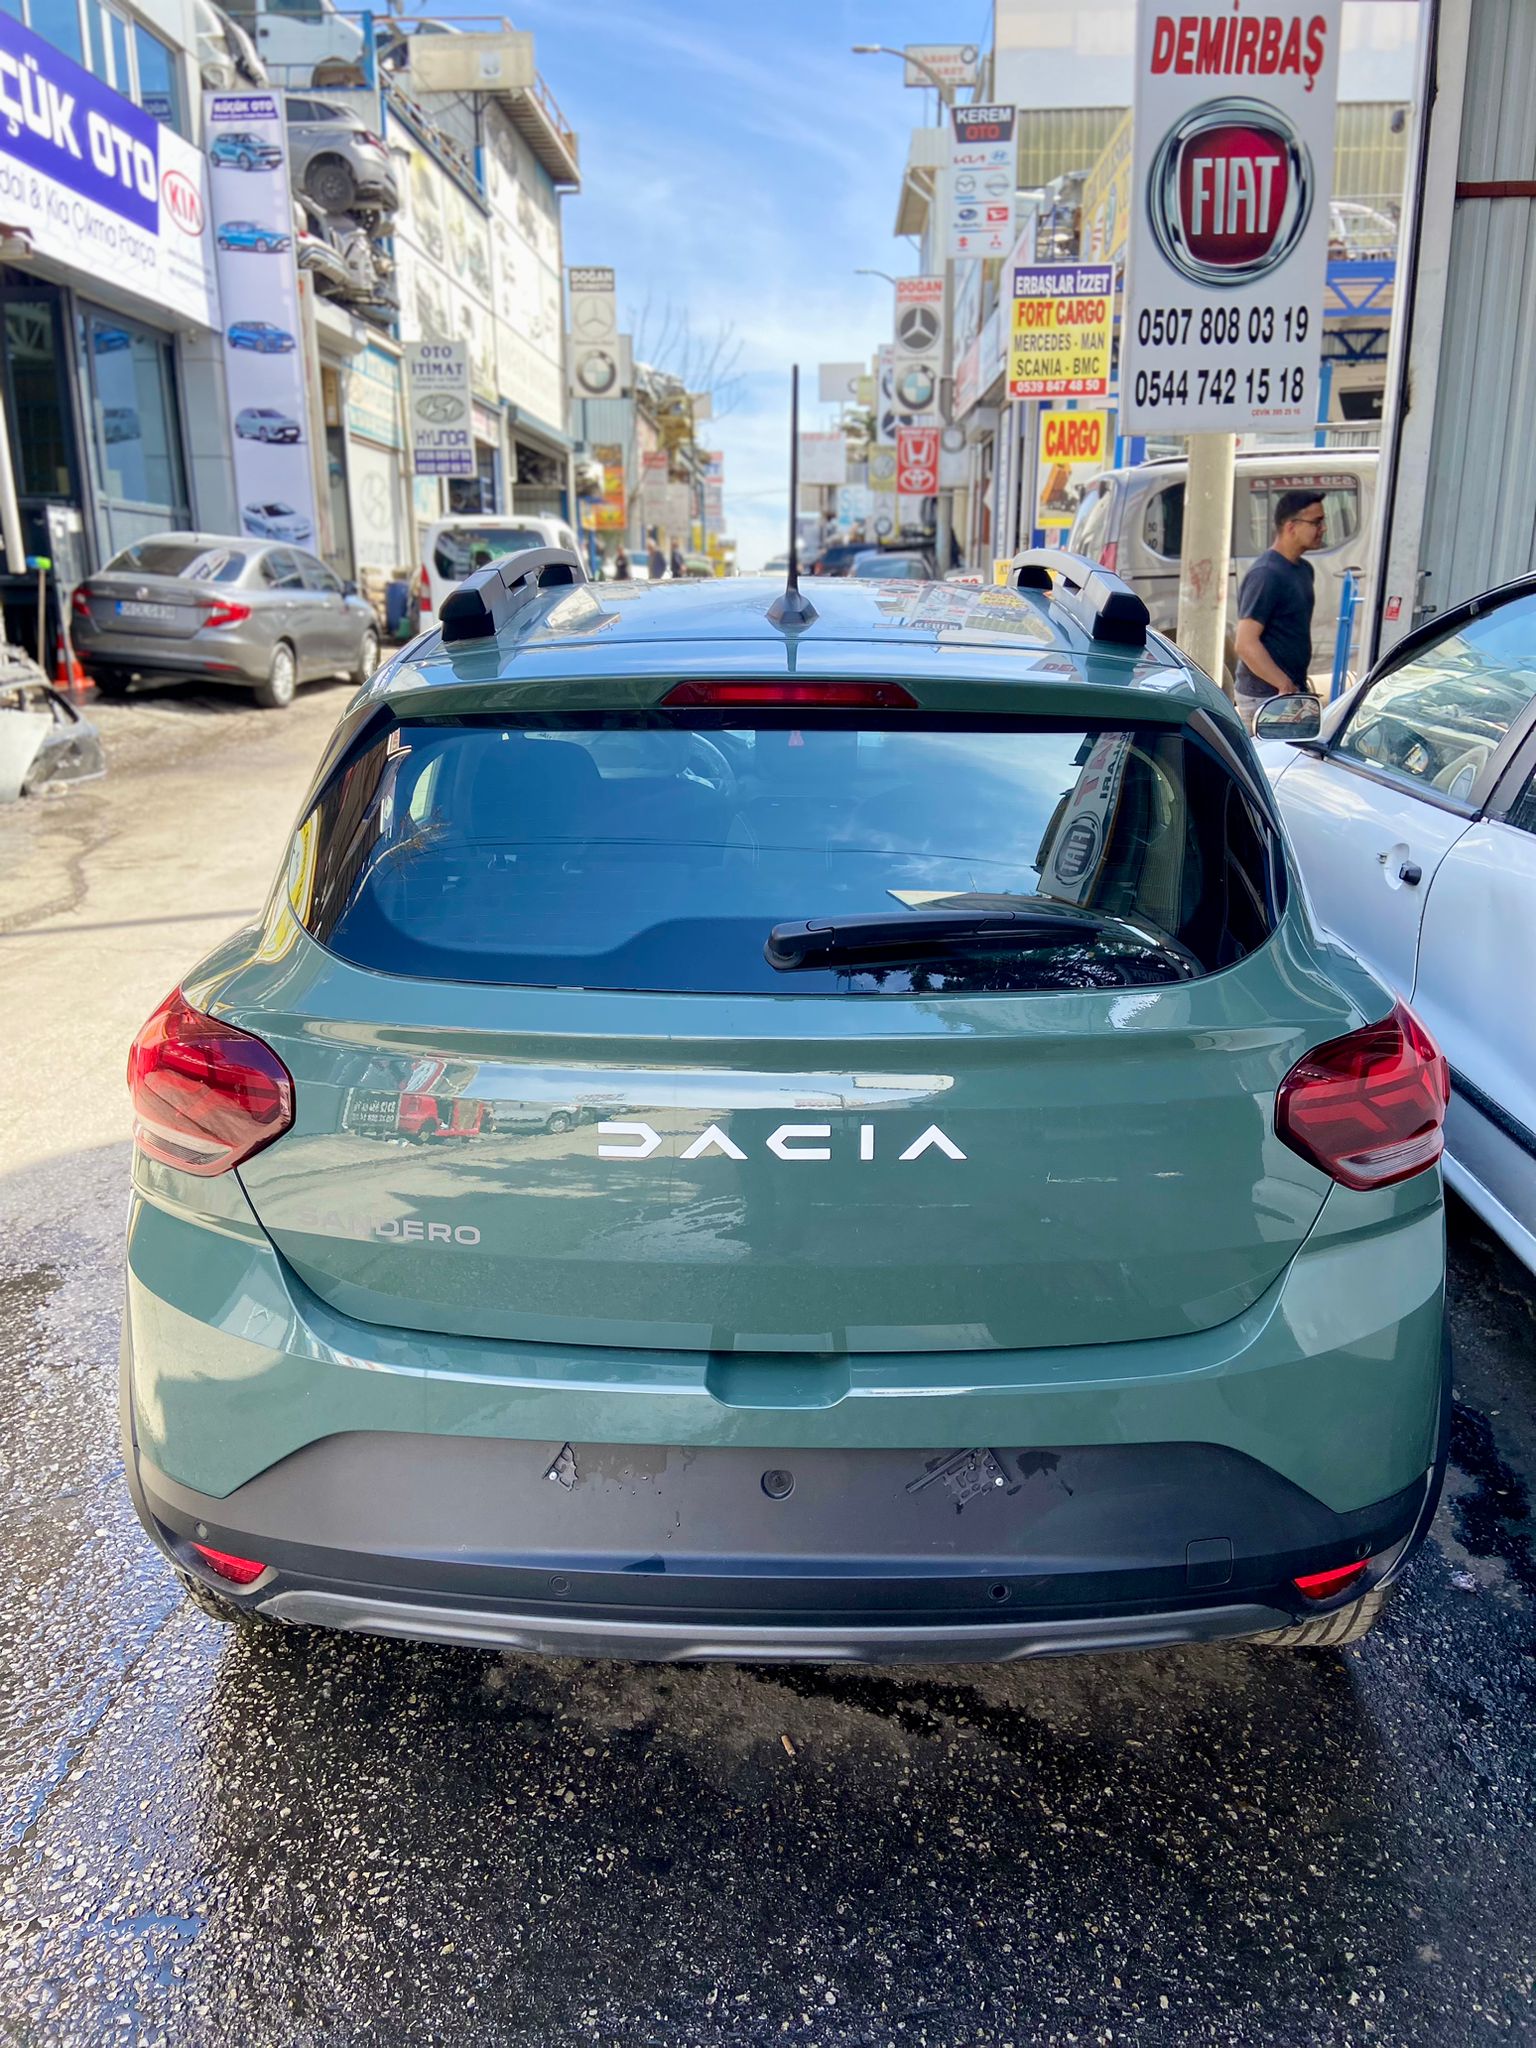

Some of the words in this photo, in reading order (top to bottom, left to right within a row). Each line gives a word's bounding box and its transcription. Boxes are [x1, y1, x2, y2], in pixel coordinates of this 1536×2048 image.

[1151, 0, 1327, 92] DEMİRBAŞ
[250, 99, 274, 112] OTO
[957, 107, 1012, 124] KEREM
[966, 125, 1000, 140] OTO
[87, 110, 157, 202] OTO
[169, 179, 201, 228] KIA
[1191, 156, 1280, 236] FIAT
[571, 270, 613, 282] DOĞAN
[897, 279, 942, 293] DOĞAN
[1015, 274, 1074, 297] ERBAŞLAR
[1076, 269, 1110, 293] İZZET
[1017, 301, 1054, 327] FORT
[1056, 299, 1106, 325] CARGO
[1138, 308, 1193, 346] 0507
[1200, 307, 1240, 345] 808
[1248, 306, 1274, 344] 03
[1285, 305, 1309, 343] 19
[420, 345, 452, 358] OTO
[1014, 333, 1071, 352] MERCEDES
[1081, 332, 1105, 349] MAN
[411, 359, 463, 375] İTİMAT
[1016, 359, 1062, 376] SCANIA
[1073, 357, 1100, 374] BMC
[1016, 382, 1045, 393] 0539
[1046, 381, 1067, 392] 847
[1135, 370, 1188, 407] 0544
[1198, 368, 1236, 405] 742
[1246, 368, 1270, 404] 15
[1280, 366, 1304, 403] 18
[1045, 419, 1100, 457] CARGO
[597, 1121, 968, 1160] DACIA
[298, 1203, 481, 1245] SANDERO
